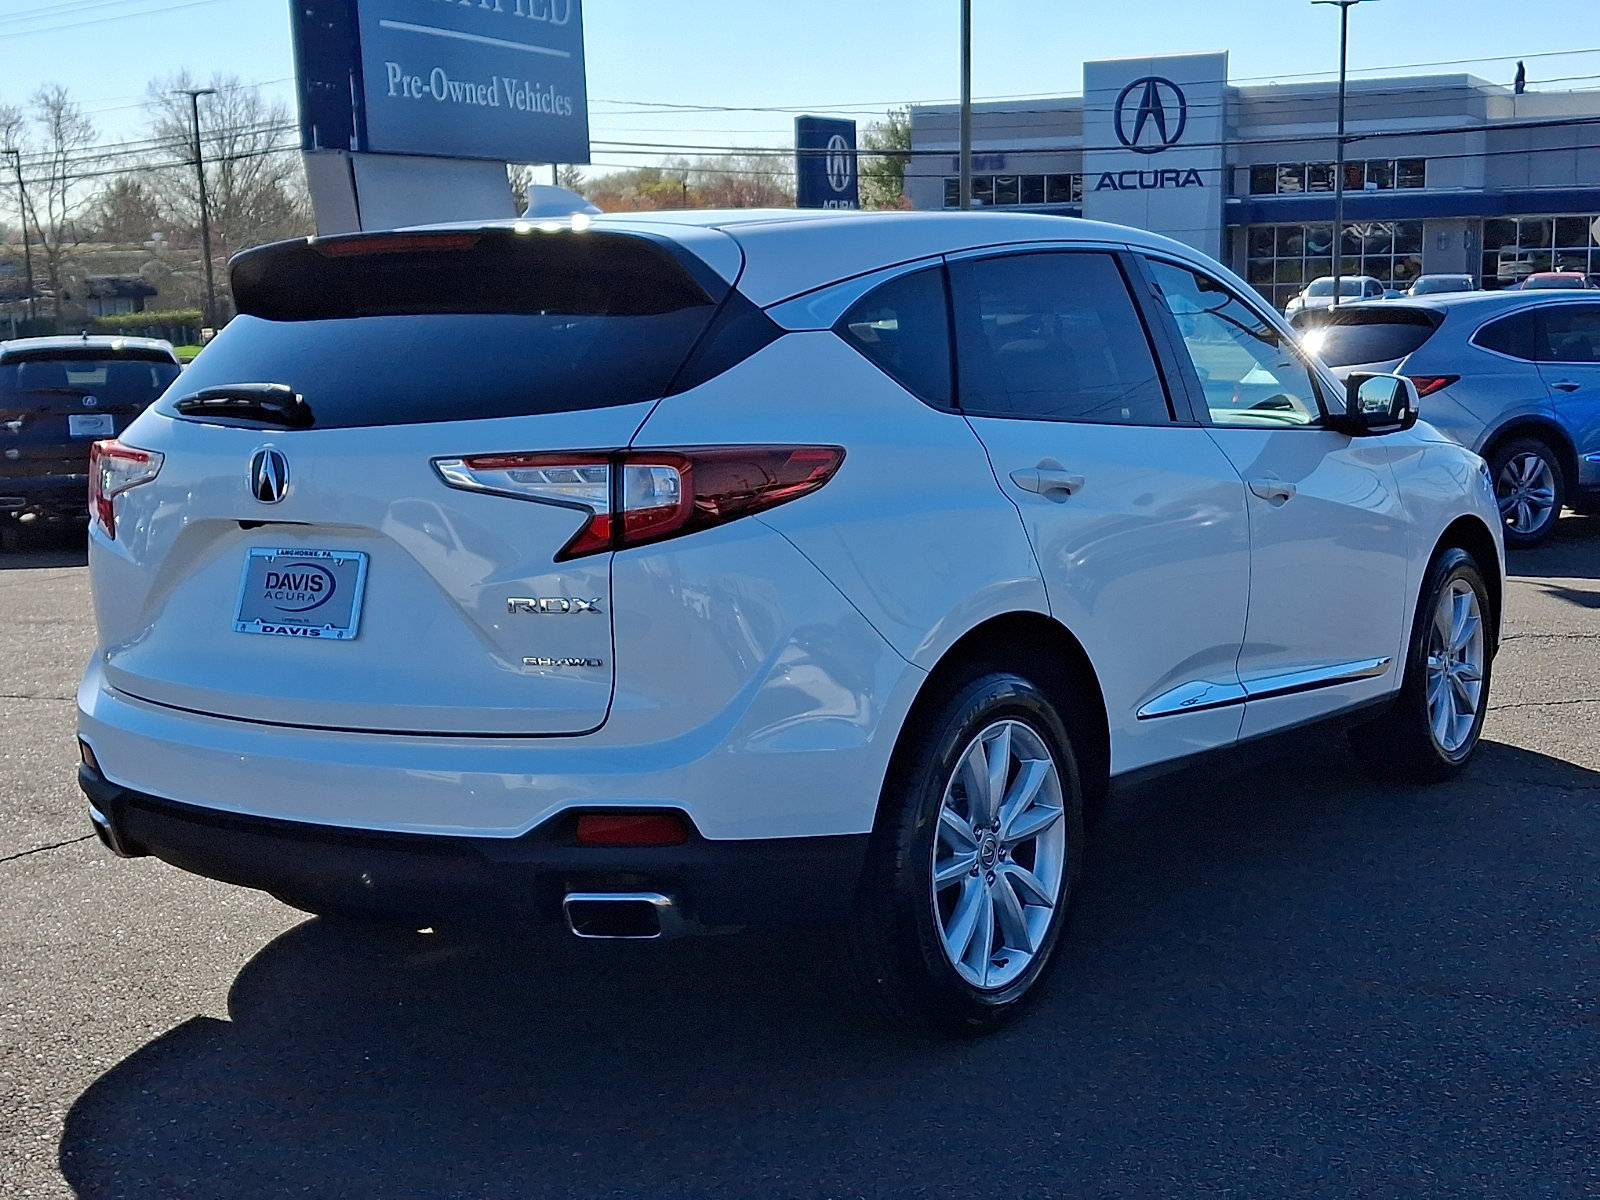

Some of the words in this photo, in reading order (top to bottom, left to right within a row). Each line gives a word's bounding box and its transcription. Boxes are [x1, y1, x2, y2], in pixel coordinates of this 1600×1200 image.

[386, 62, 499, 106] Pre-Owned
[502, 78, 572, 116] Vehicles
[1095, 168, 1203, 191] ACURA
[265, 572, 323, 592] DAVIS
[264, 591, 316, 602] ACURA
[507, 597, 603, 614] RDX
[262, 626, 320, 636] DAVIS
